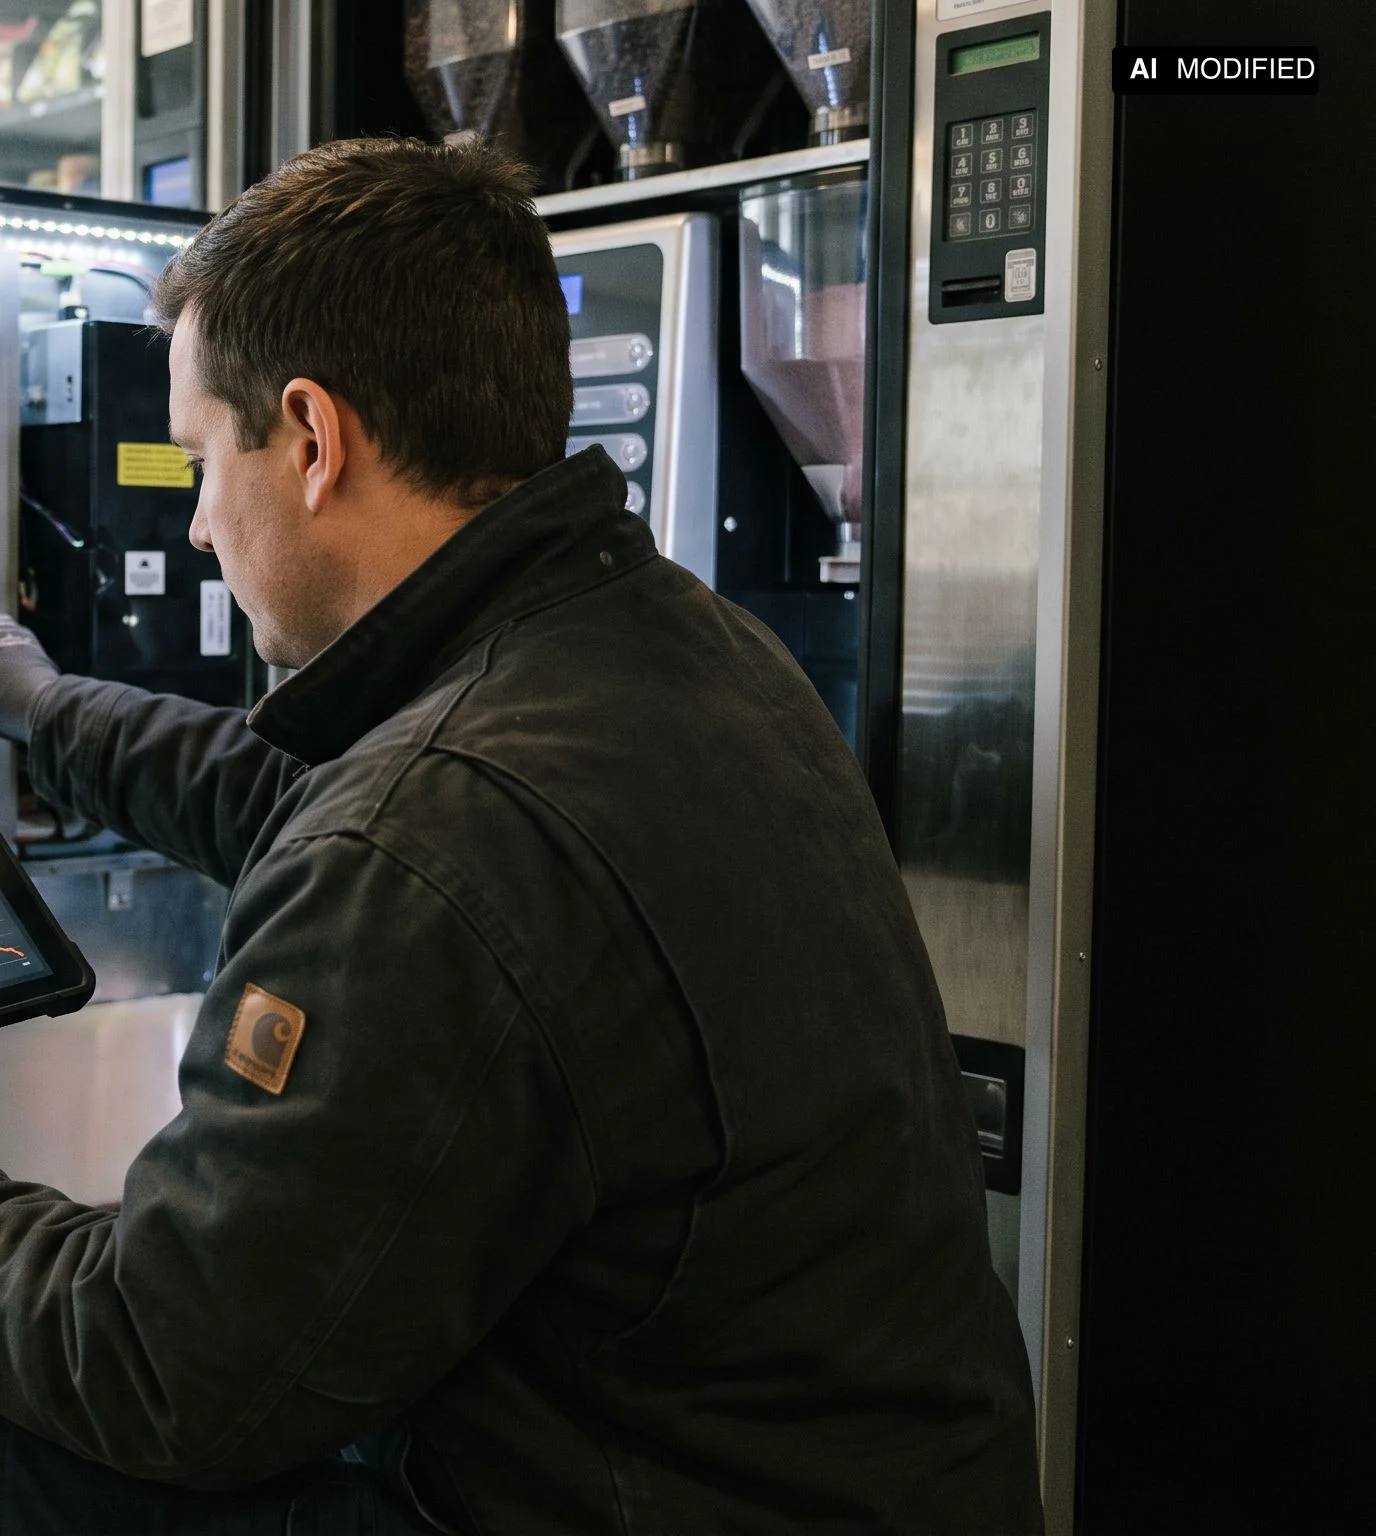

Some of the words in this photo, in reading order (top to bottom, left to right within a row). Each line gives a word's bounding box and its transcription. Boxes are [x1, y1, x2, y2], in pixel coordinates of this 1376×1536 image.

[988, 151, 996, 164] 5
[1017, 147, 1026, 159] 6
[957, 157, 967, 168] 4
[987, 182, 996, 193] 8
[985, 213, 996, 229] 0
